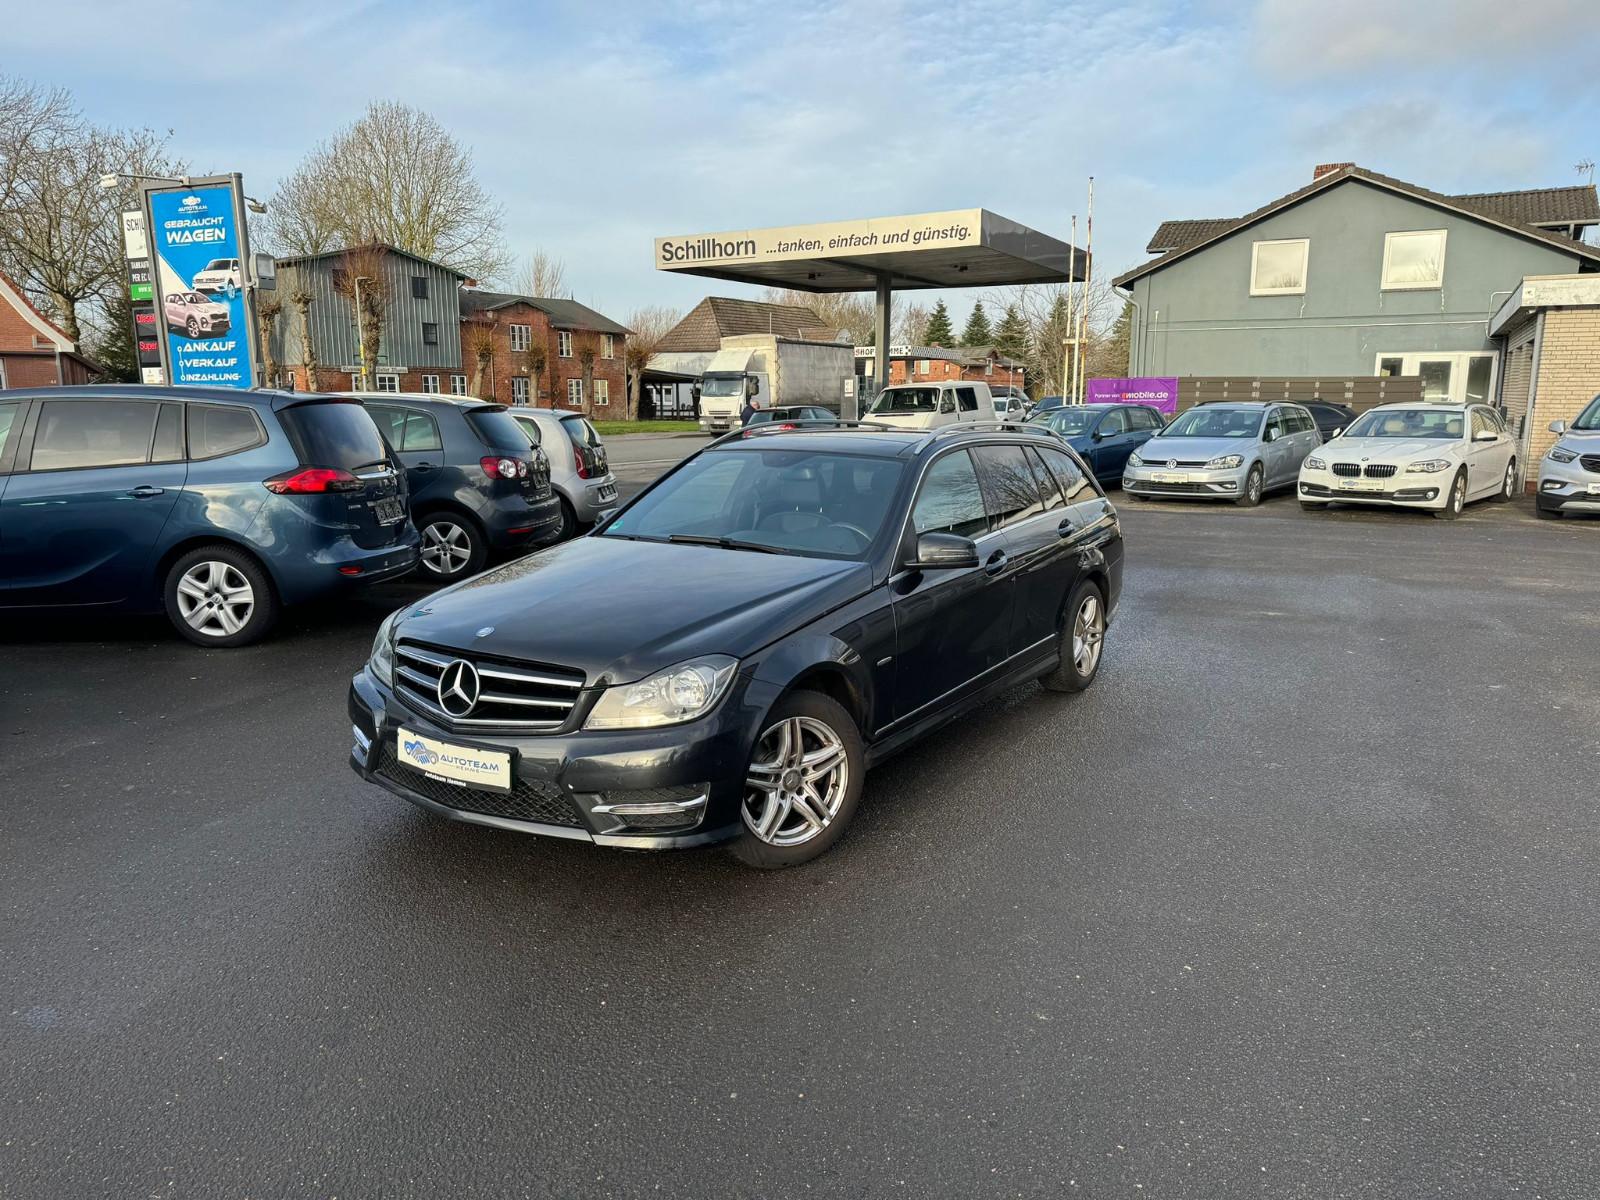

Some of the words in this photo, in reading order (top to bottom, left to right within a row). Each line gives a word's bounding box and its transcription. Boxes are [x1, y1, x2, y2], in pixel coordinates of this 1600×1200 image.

[164, 216, 224, 229] GEBRAUCHT
[166, 227, 226, 244] WAGEN
[662, 238, 756, 261] Schillhorn
[766, 238, 824, 253] ...tanken,
[828, 233, 877, 249] einfach
[882, 229, 910, 244] und
[913, 225, 971, 245] günstig.
[183, 341, 236, 353] ANKAUF
[184, 357, 238, 368] VERKAUF
[1126, 391, 1168, 399] mobile.de
[440, 754, 499, 772] AUTOTEAM
